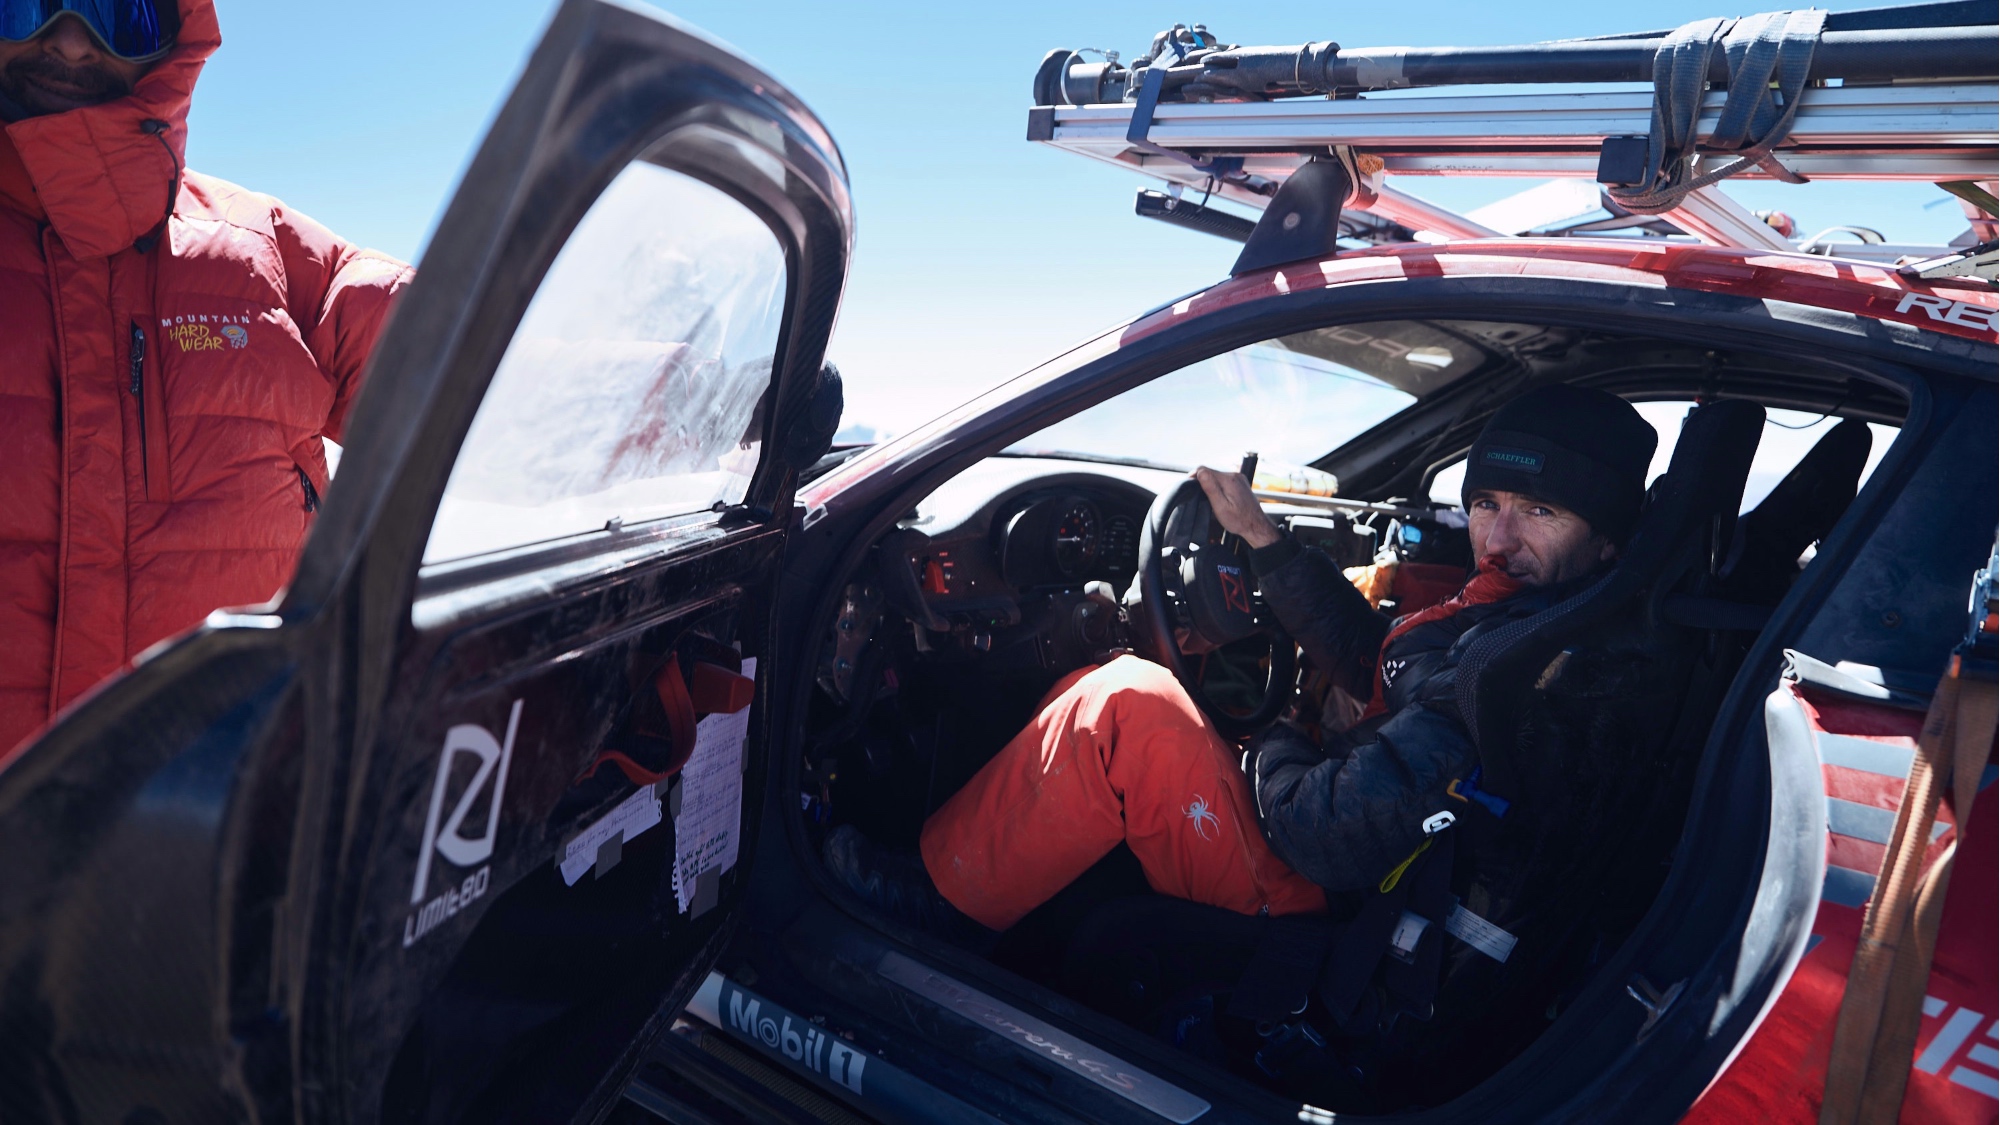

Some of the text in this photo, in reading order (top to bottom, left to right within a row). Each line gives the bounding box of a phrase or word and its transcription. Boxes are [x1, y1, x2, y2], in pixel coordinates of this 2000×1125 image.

[1895, 291, 1999, 333] RE
[161, 314, 250, 327] MOUNTAIN
[169, 324, 210, 341] HARD
[179, 336, 225, 352] WEAR
[1486, 452, 1536, 466] SCHAEFFLER
[729, 989, 826, 1075] Mobil
